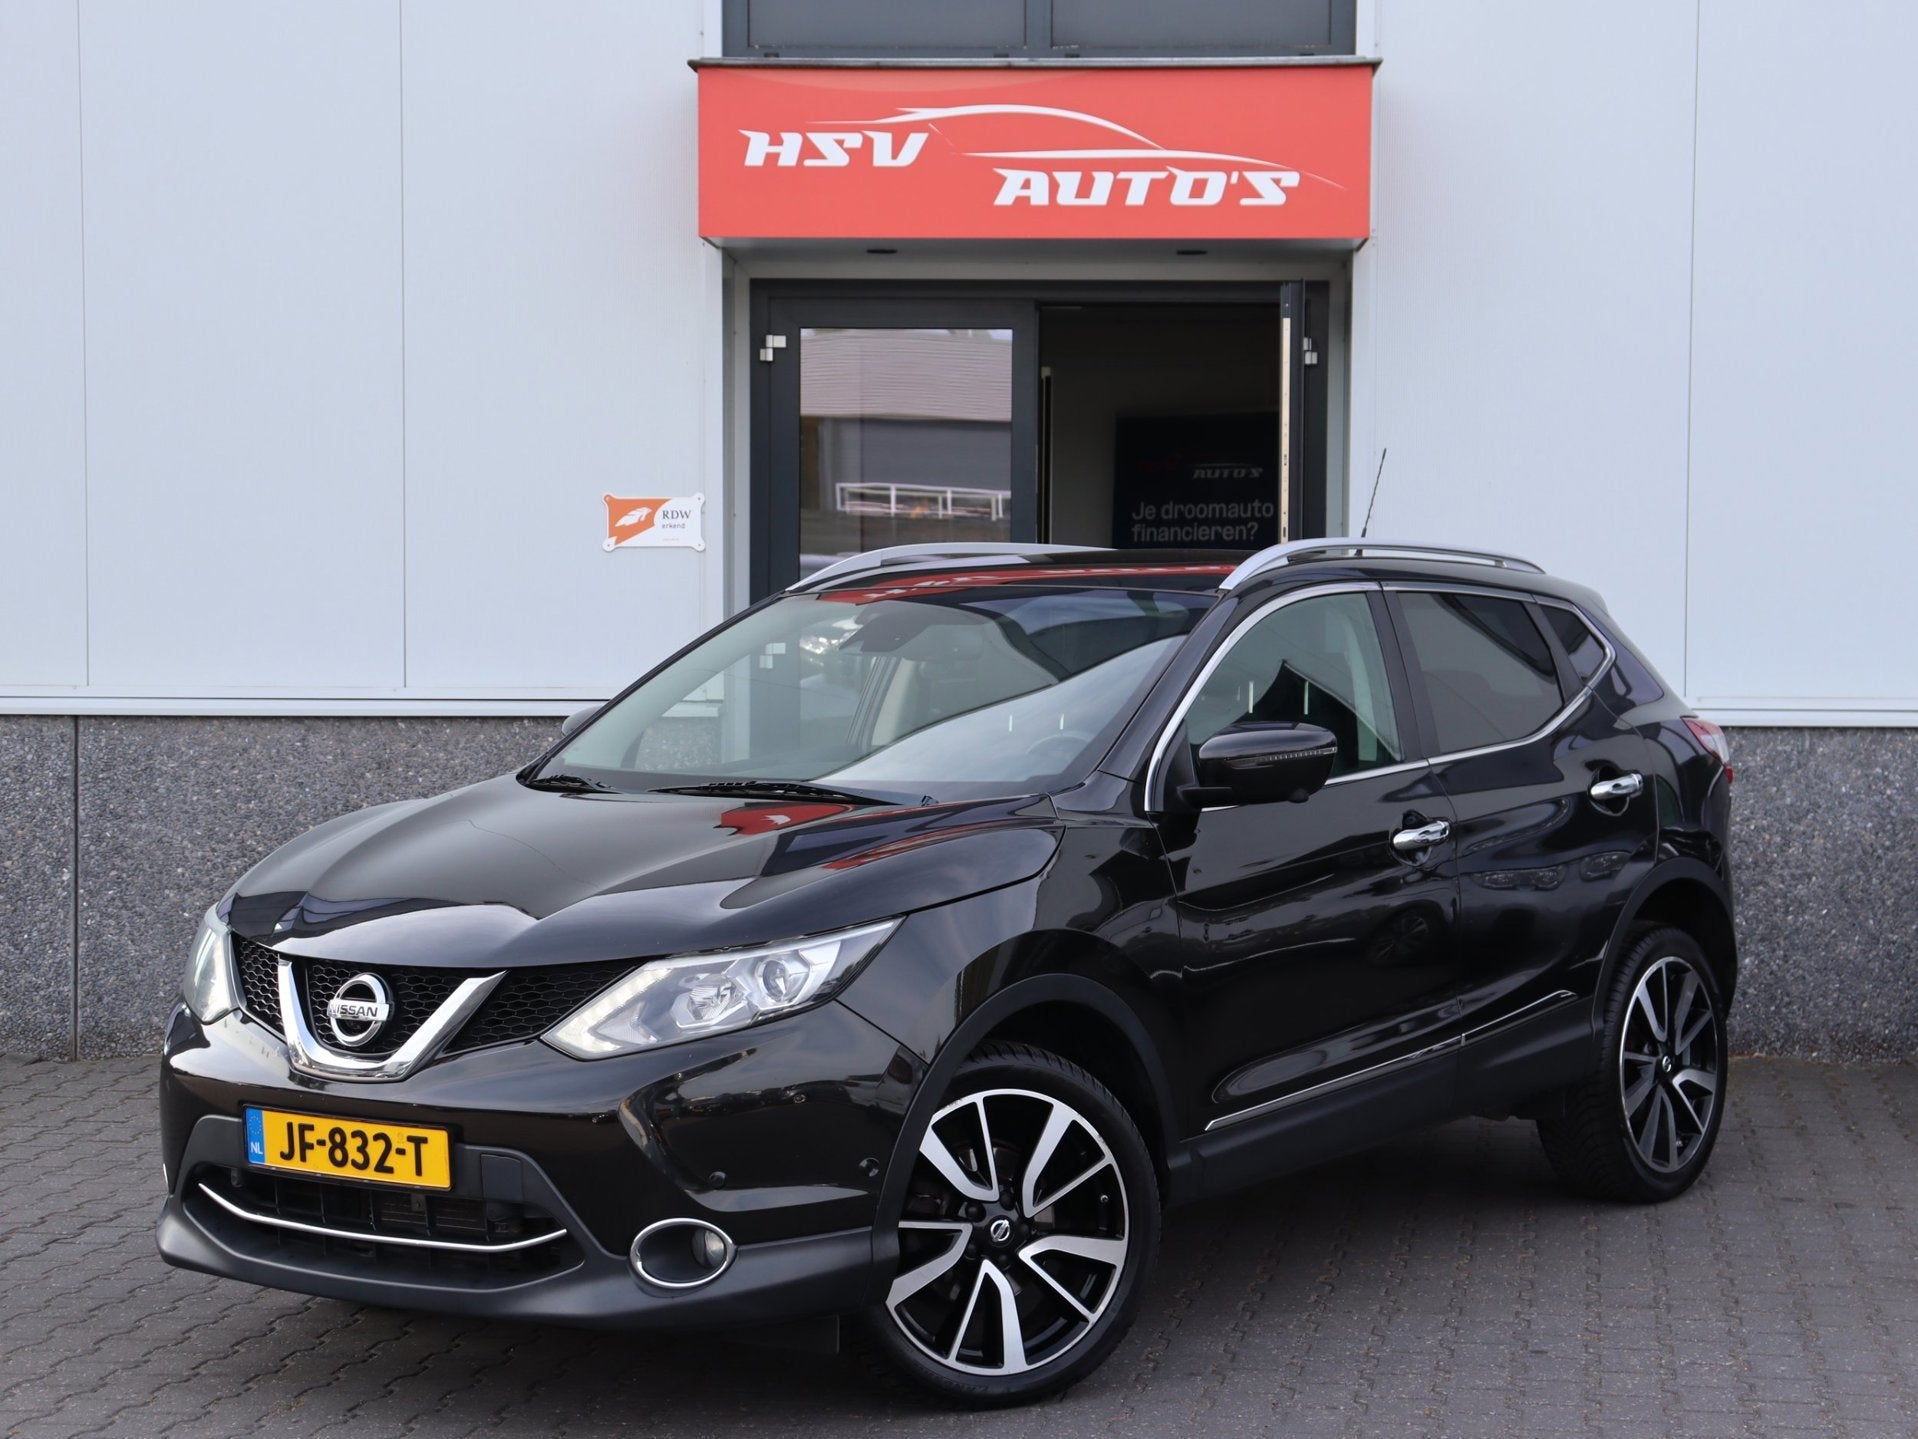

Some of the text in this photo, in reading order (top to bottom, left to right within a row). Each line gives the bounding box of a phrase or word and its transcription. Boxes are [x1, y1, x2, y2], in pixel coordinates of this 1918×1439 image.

[739, 130, 928, 168] HSV
[993, 167, 1300, 206] AUTO'S
[662, 510, 691, 520] RDW
[1132, 500, 1274, 520] Je droomauto
[1131, 522, 1258, 542] financieren?
[250, 1121, 428, 1177] NL JF-832-T
